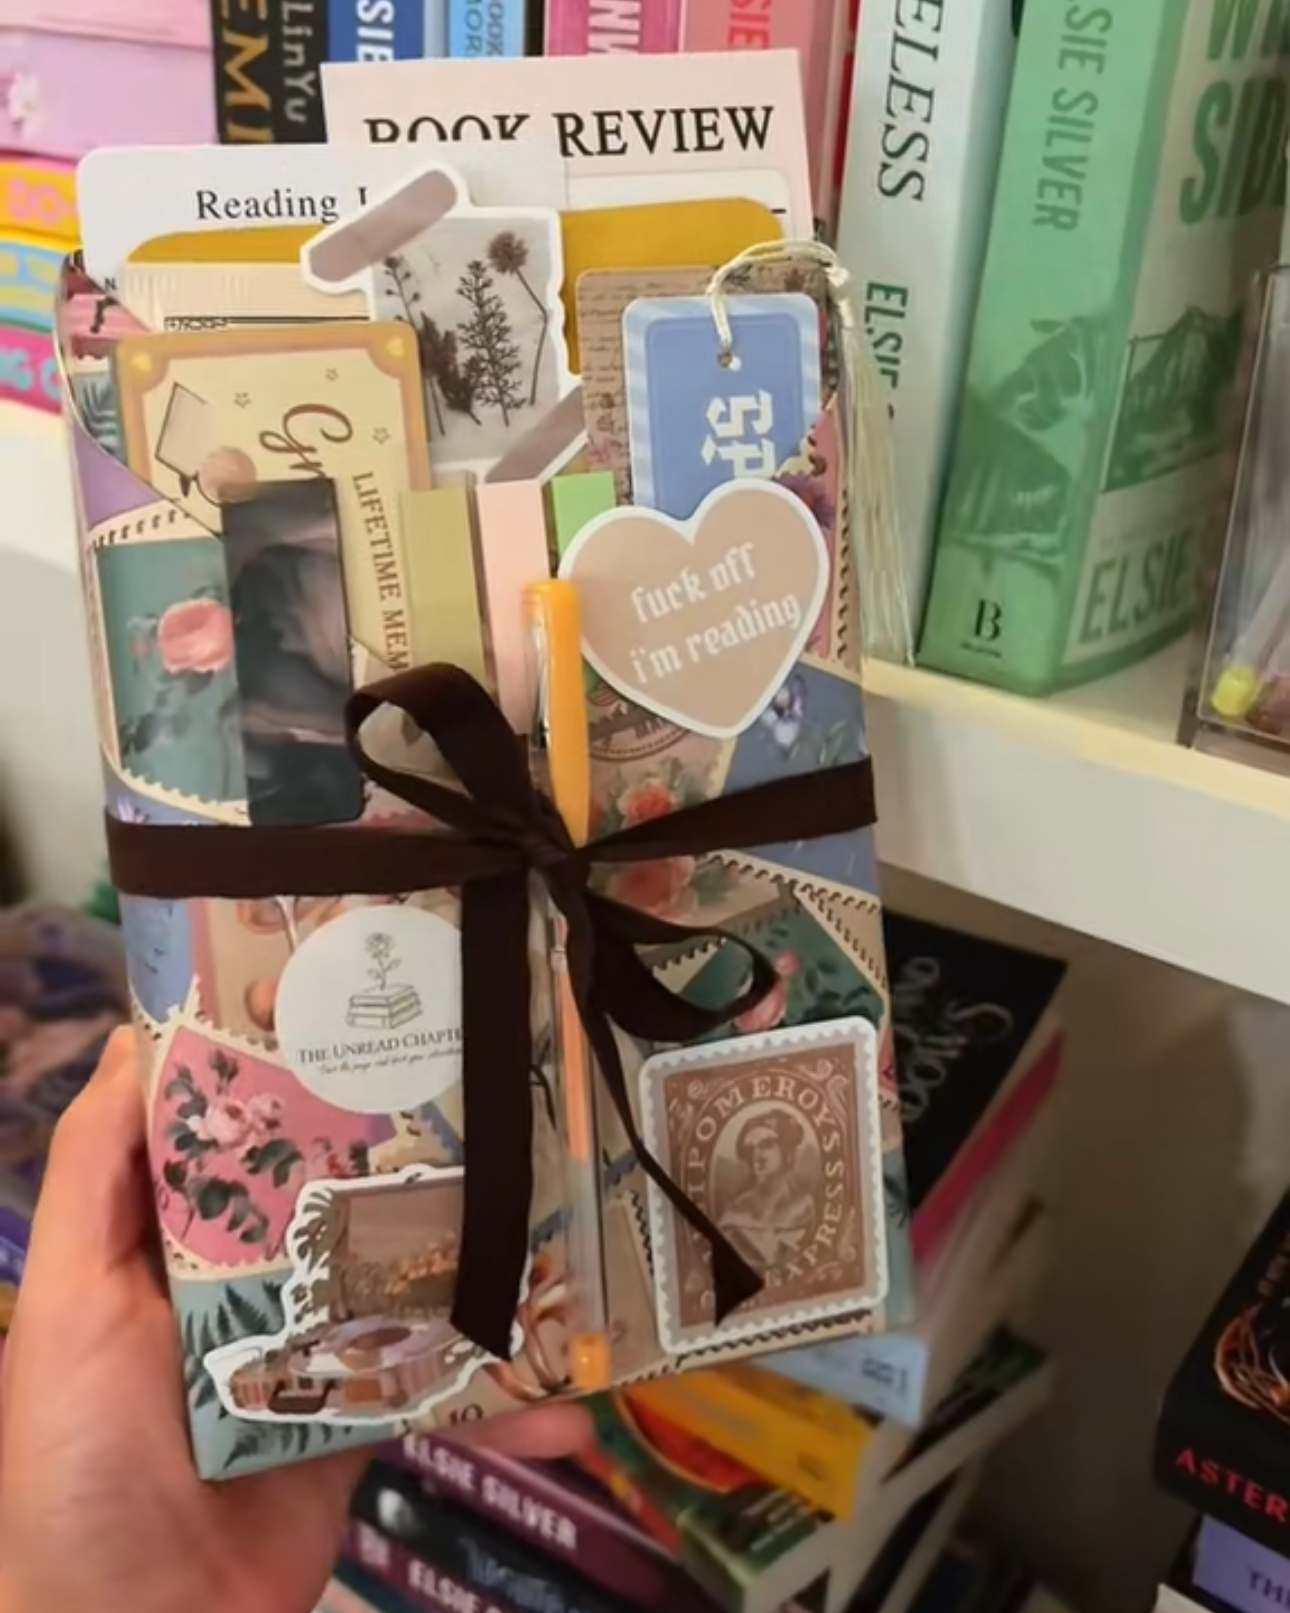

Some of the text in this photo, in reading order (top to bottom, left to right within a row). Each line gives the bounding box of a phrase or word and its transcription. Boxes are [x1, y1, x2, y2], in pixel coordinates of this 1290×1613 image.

[552, 105, 774, 158] REVIEW
[1032, 87, 1100, 232] SILVER
[196, 187, 340, 224] Reading
[352, 470, 401, 601] LIFETIME
[631, 542, 756, 624] fuck off
[629, 593, 801, 684] i'm reading
[300, 1045, 327, 1063] THE
[333, 1037, 400, 1058] UNREAD
[481, 1474, 578, 1550] SILVER
[1174, 1446, 1288, 1524] ASTER
